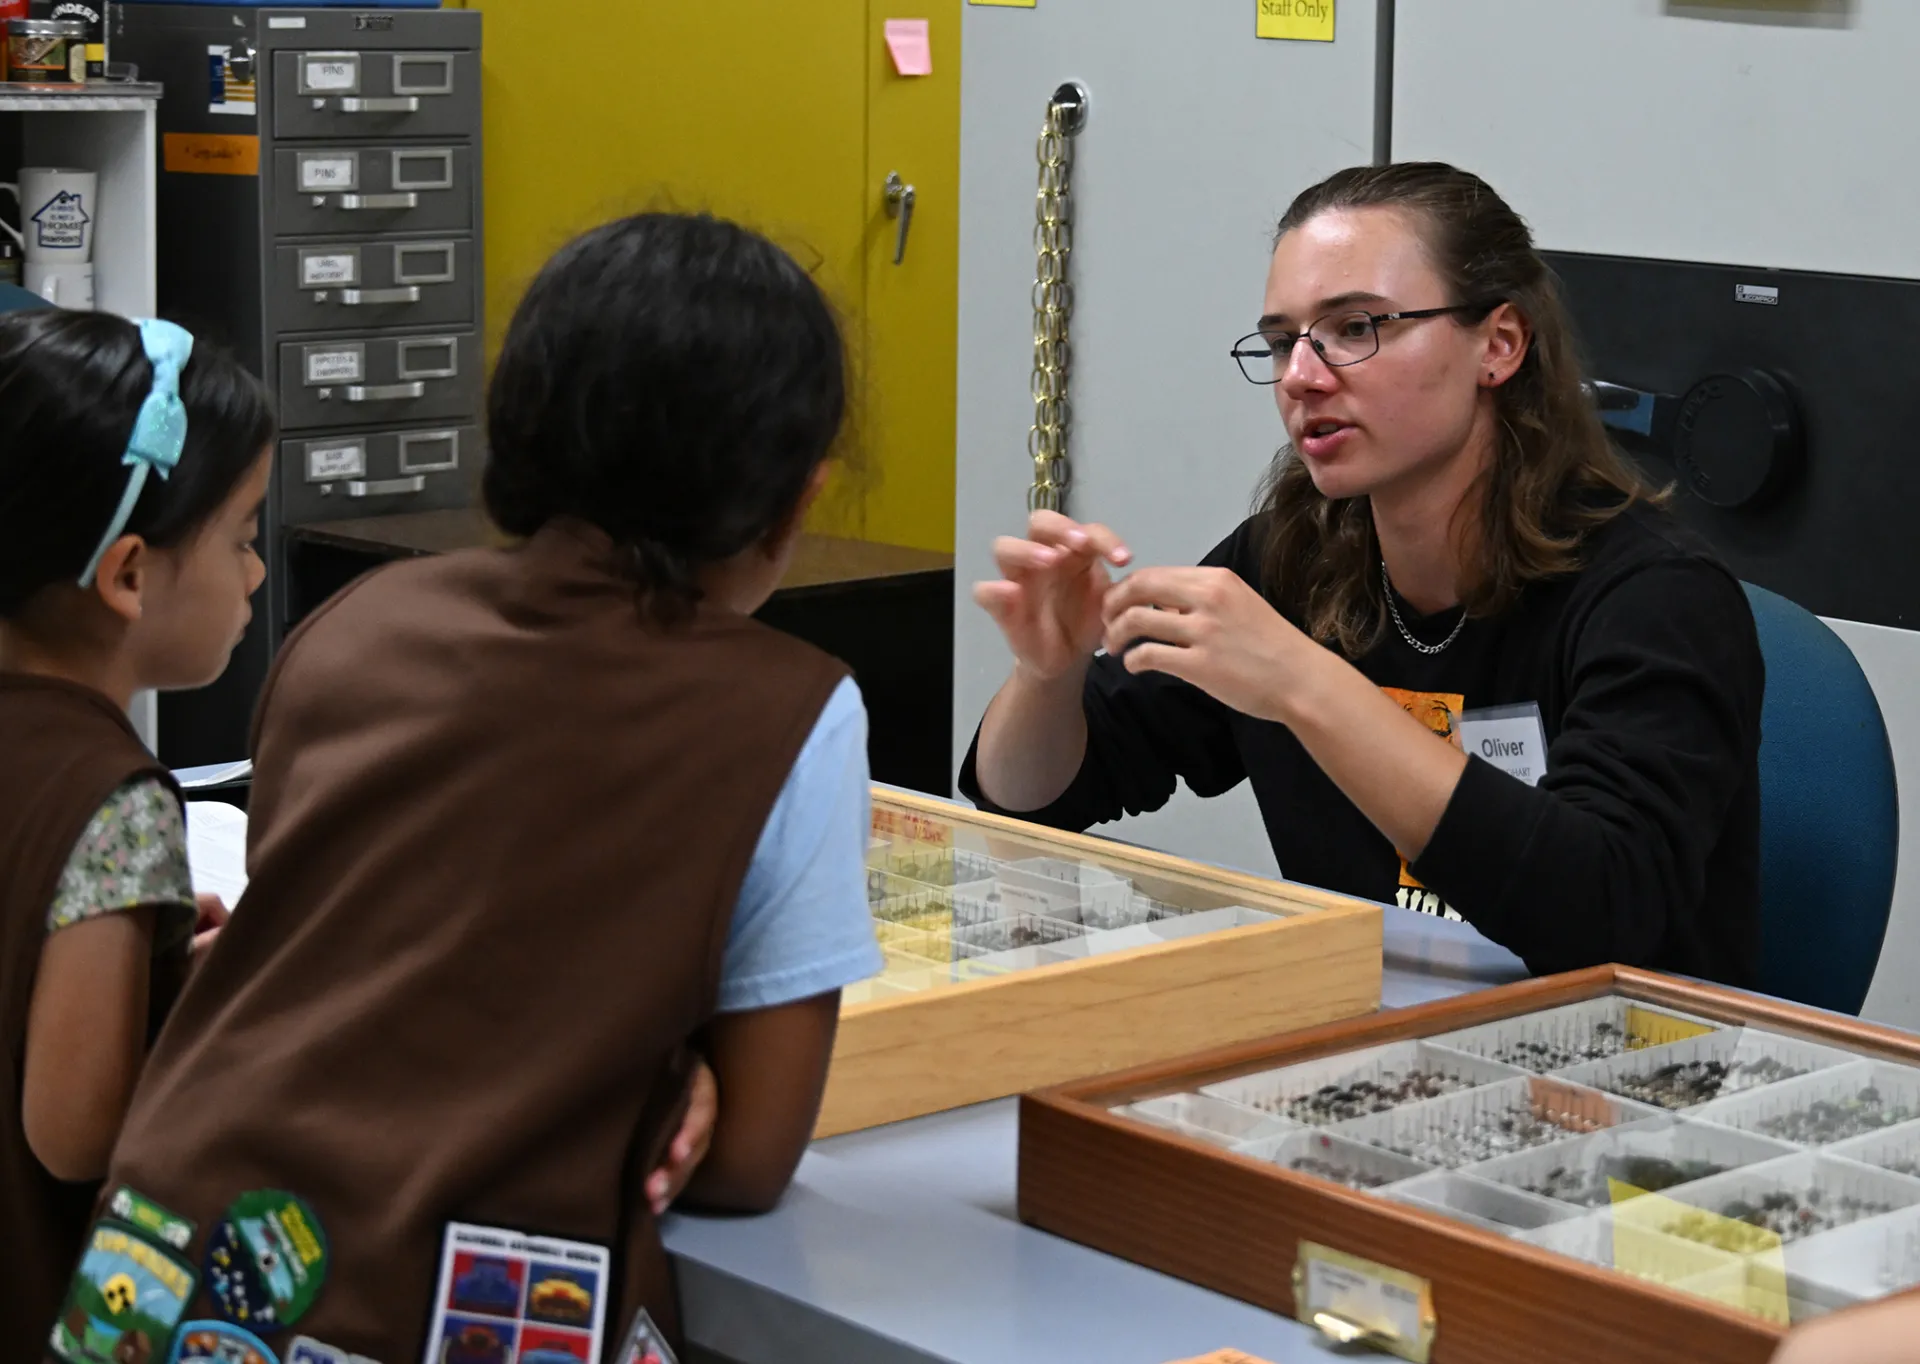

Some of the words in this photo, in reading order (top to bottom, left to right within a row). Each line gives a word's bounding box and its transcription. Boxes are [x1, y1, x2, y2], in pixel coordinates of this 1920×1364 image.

[1261, 0, 1291, 16] Staff
[1295, 0, 1329, 24] Only
[322, 65, 344, 76] PINS
[314, 167, 336, 178] PINS
[42, 222, 82, 230] HOME
[1481, 738, 1525, 758] Oliver
